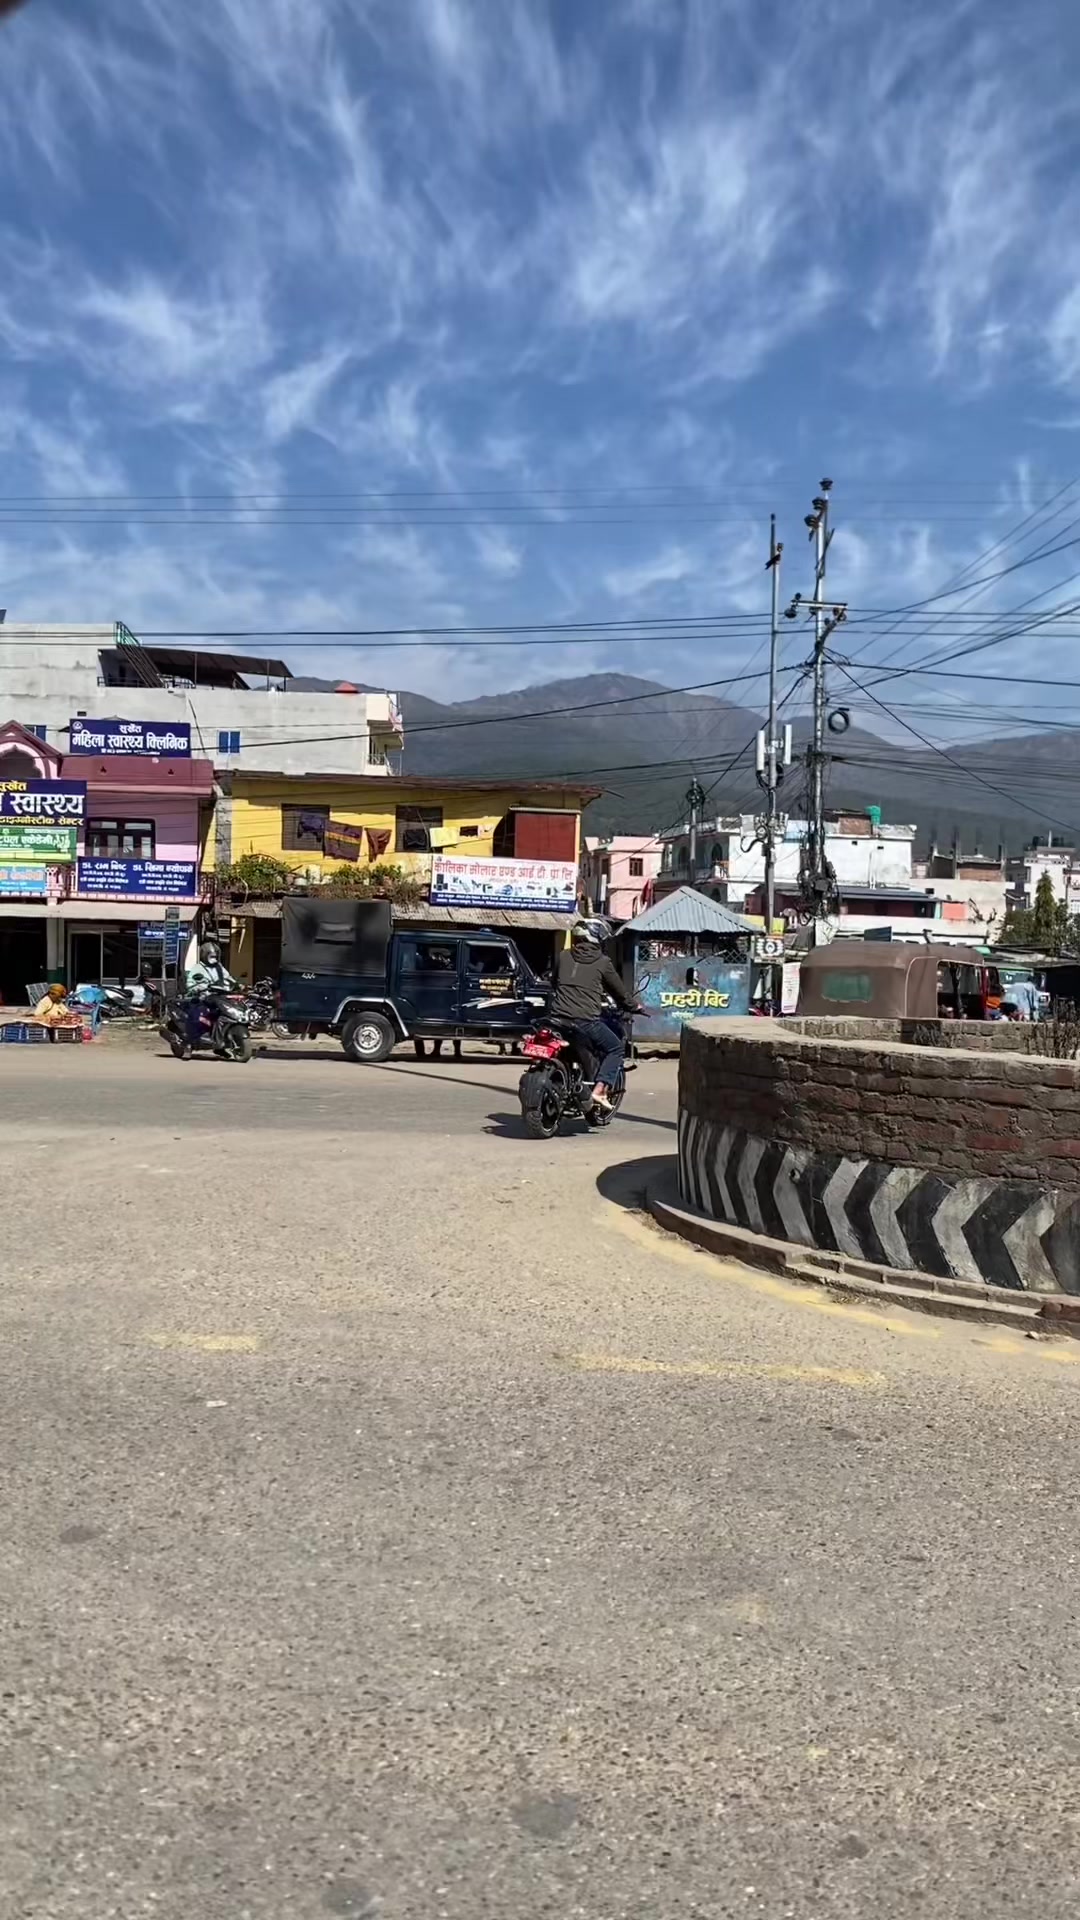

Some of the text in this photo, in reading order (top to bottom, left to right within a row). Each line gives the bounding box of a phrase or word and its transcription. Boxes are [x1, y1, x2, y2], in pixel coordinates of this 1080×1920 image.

[72, 729, 188, 750] महिला स्वास्थ्य क्लिनिक
[9, 793, 85, 815] स्वास्थ्य
[434, 861, 467, 873] कालिका
[660, 989, 729, 1008] प्रहरी बिट
